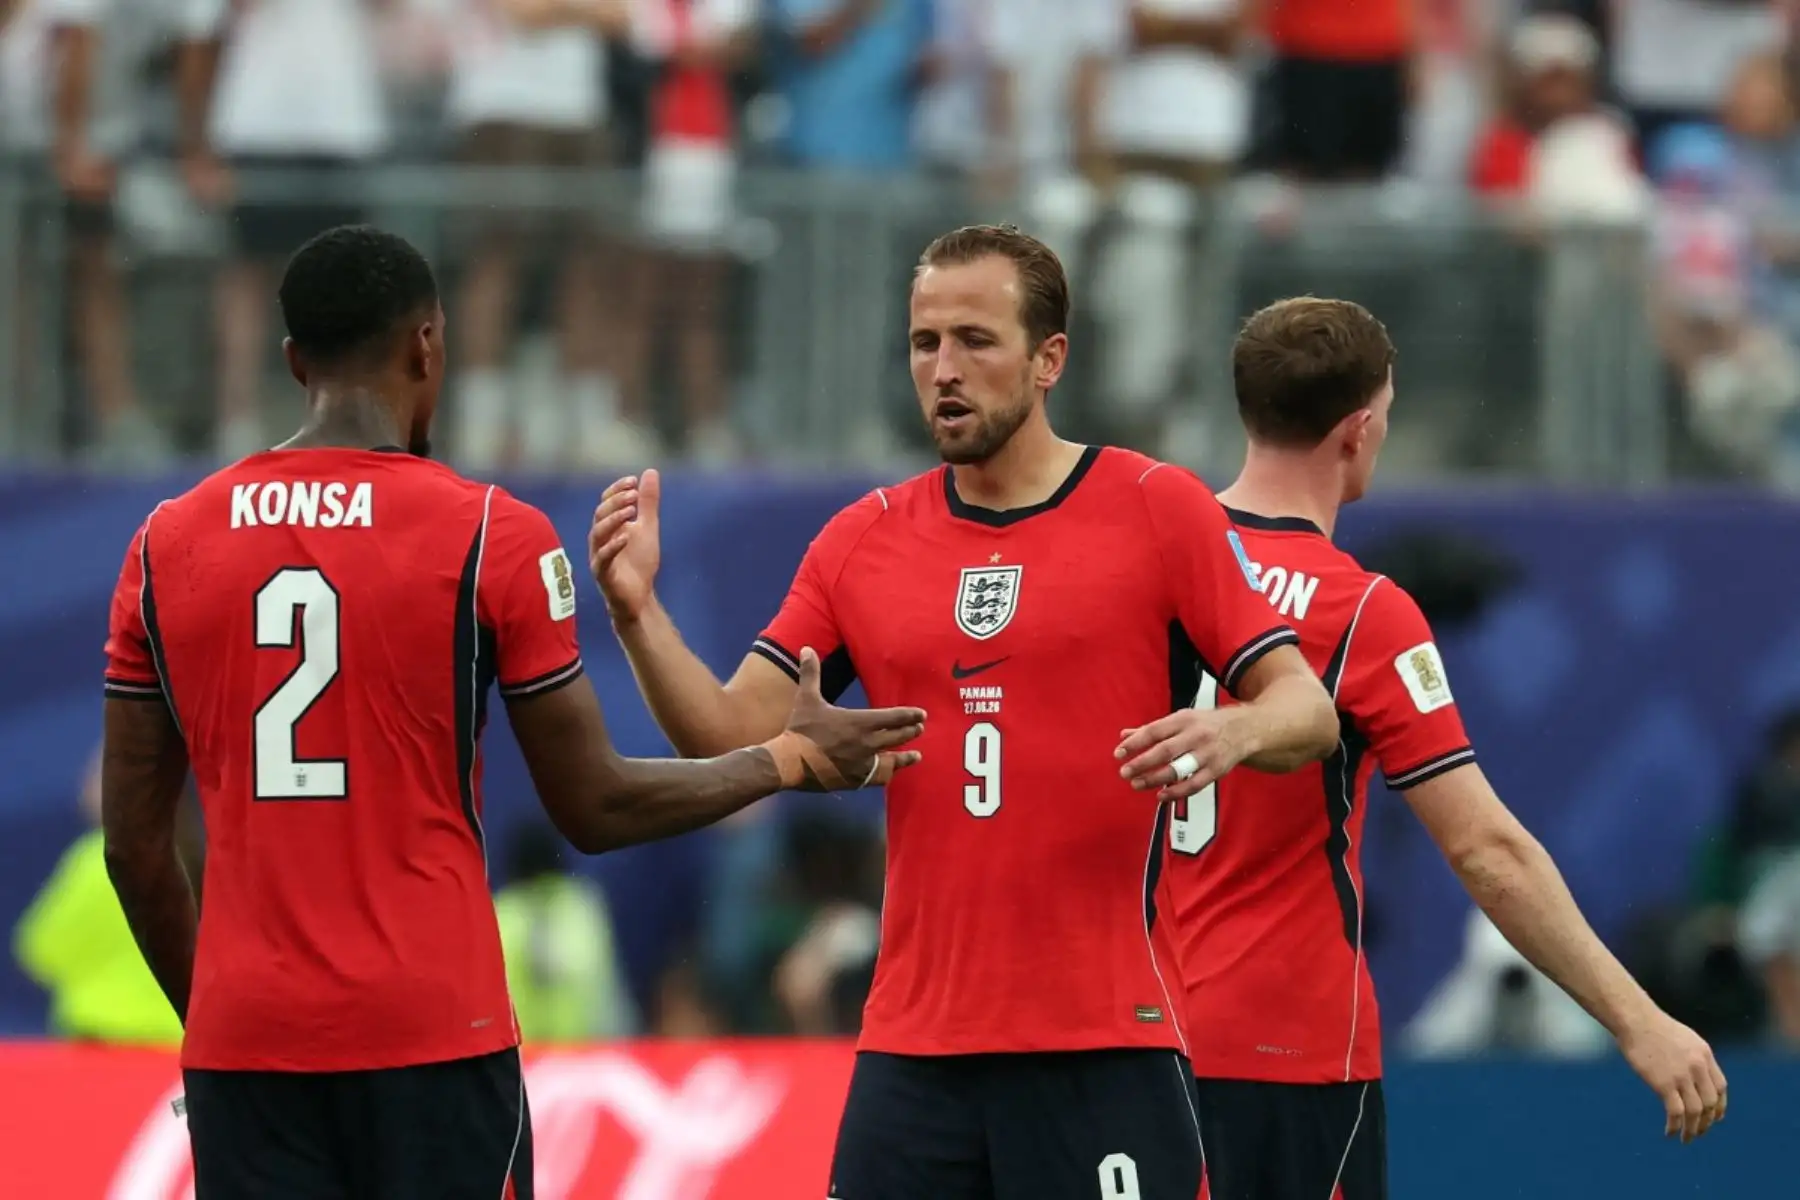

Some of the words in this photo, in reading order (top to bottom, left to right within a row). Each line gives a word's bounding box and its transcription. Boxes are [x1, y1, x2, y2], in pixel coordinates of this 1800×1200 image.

[230, 481, 372, 529] KONSA
[1250, 561, 1320, 620] ON
[253, 565, 348, 801] 2
[959, 686, 1003, 699] PANAMA
[963, 720, 1003, 819] 9
